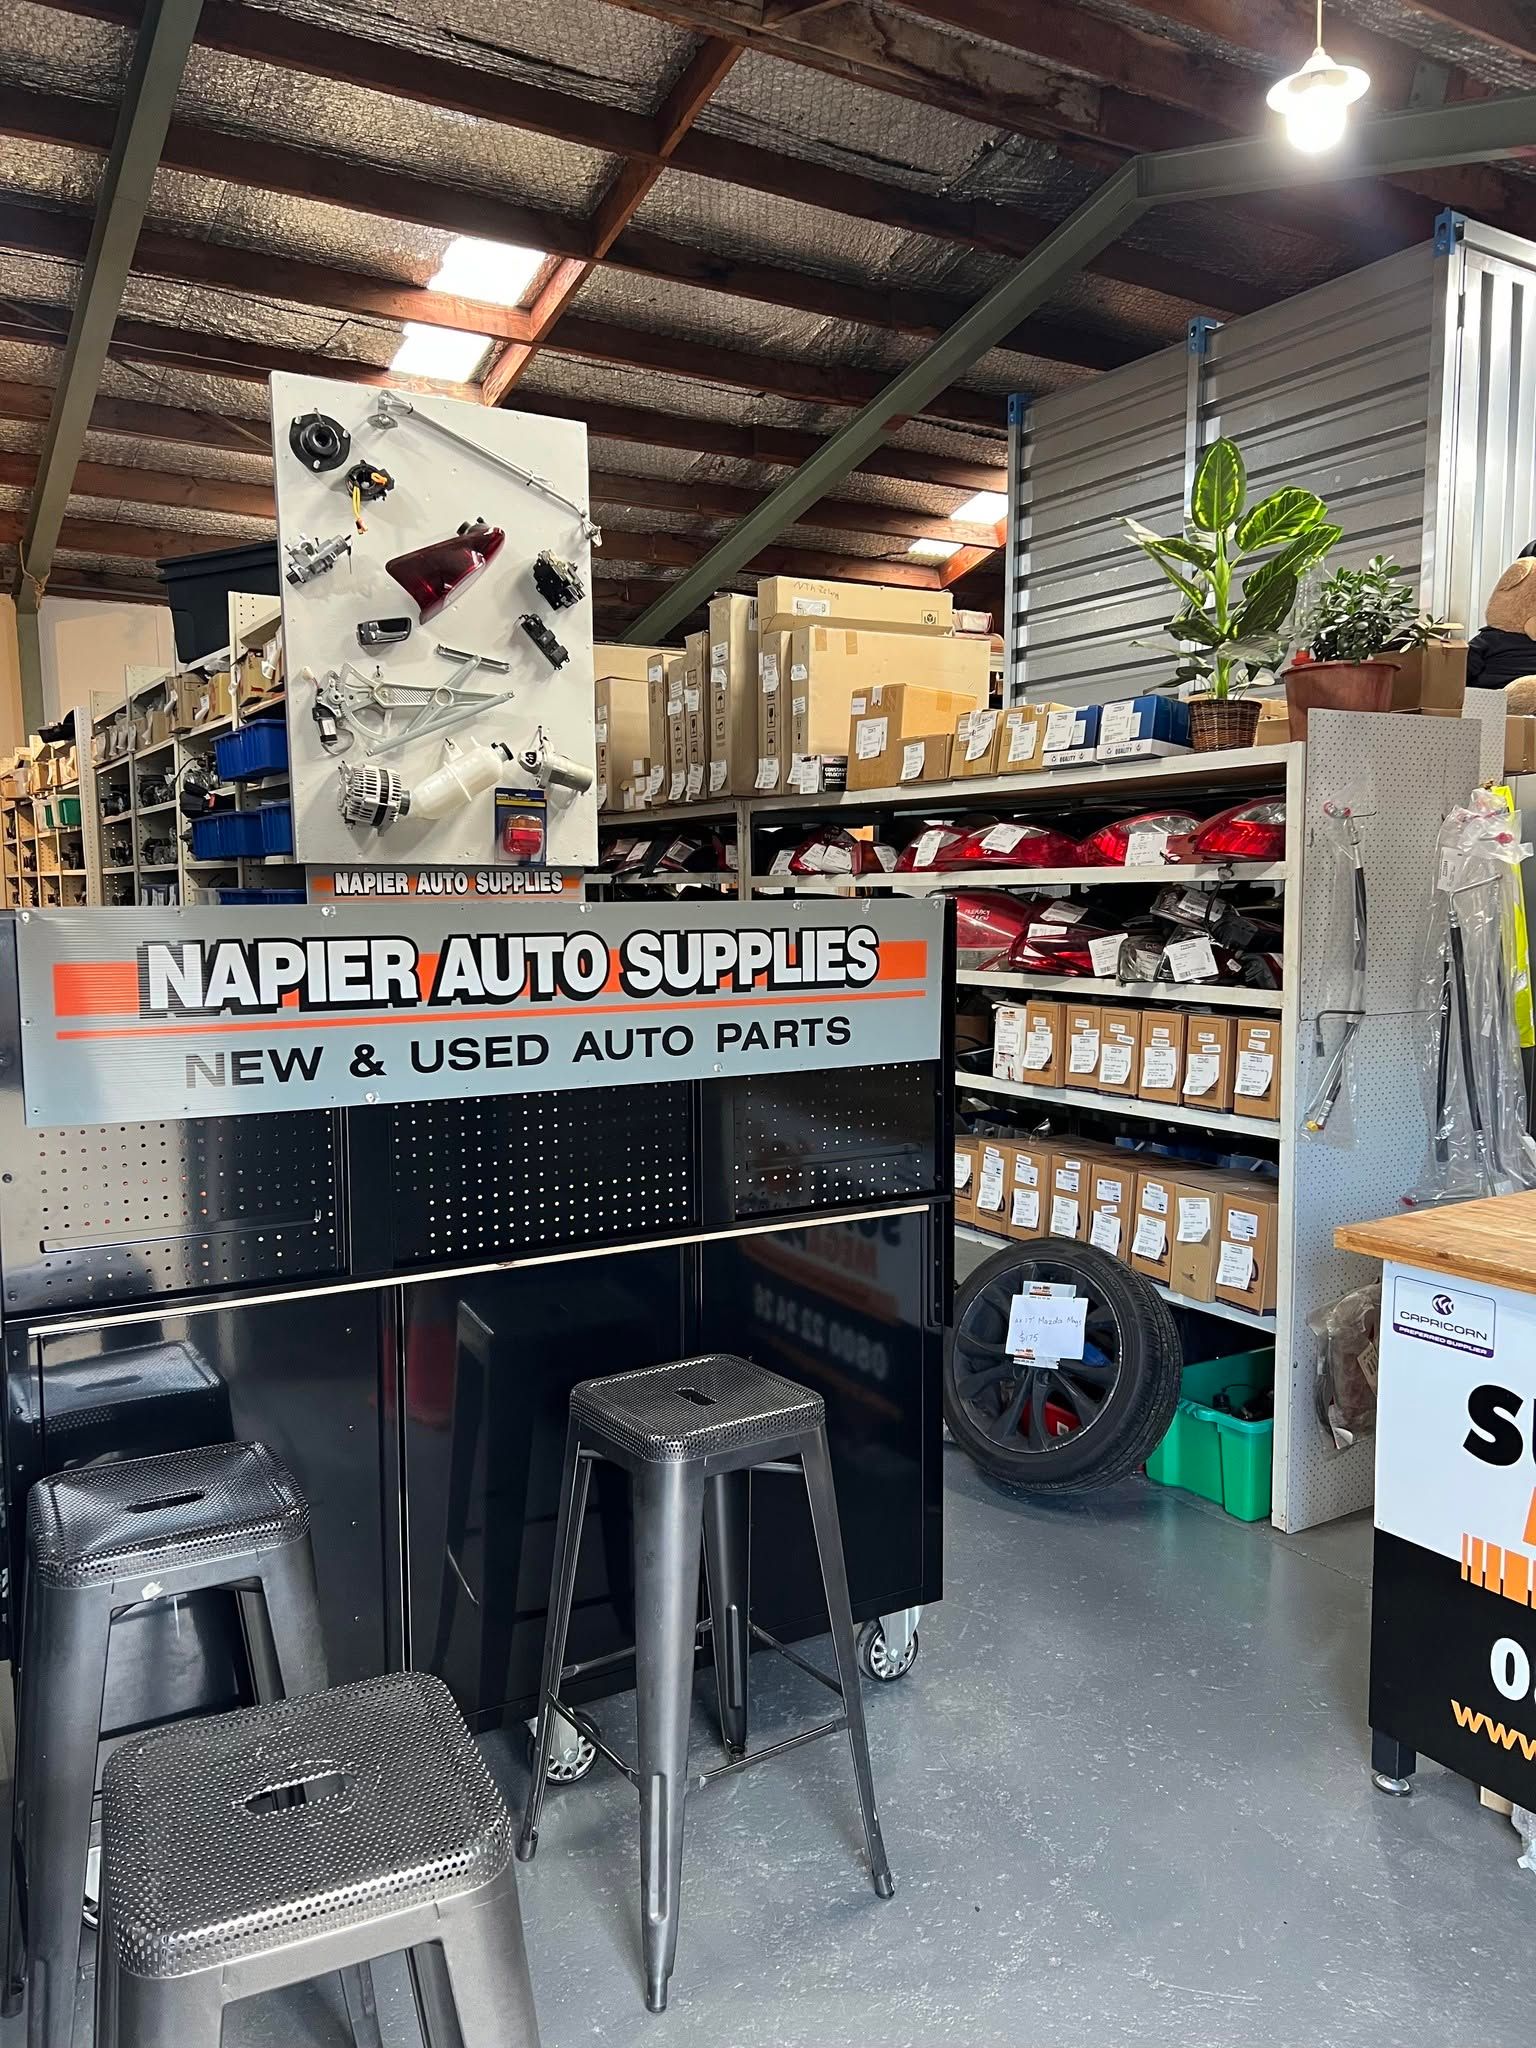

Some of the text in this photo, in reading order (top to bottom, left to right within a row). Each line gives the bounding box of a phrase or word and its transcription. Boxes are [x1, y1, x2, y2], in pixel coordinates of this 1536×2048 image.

[335, 870, 563, 896] NAPIER AUTO SUPPLIES
[138, 926, 880, 1018] NAPIER AUTO SUPPLIES
[186, 1016, 852, 1089] NEW & USED AUTO PARTS
[1398, 1326, 1487, 1355] PREFERRED SUPPLIER
[1400, 1311, 1487, 1341] CAPRICORN
[1463, 1384, 1536, 1467] S
